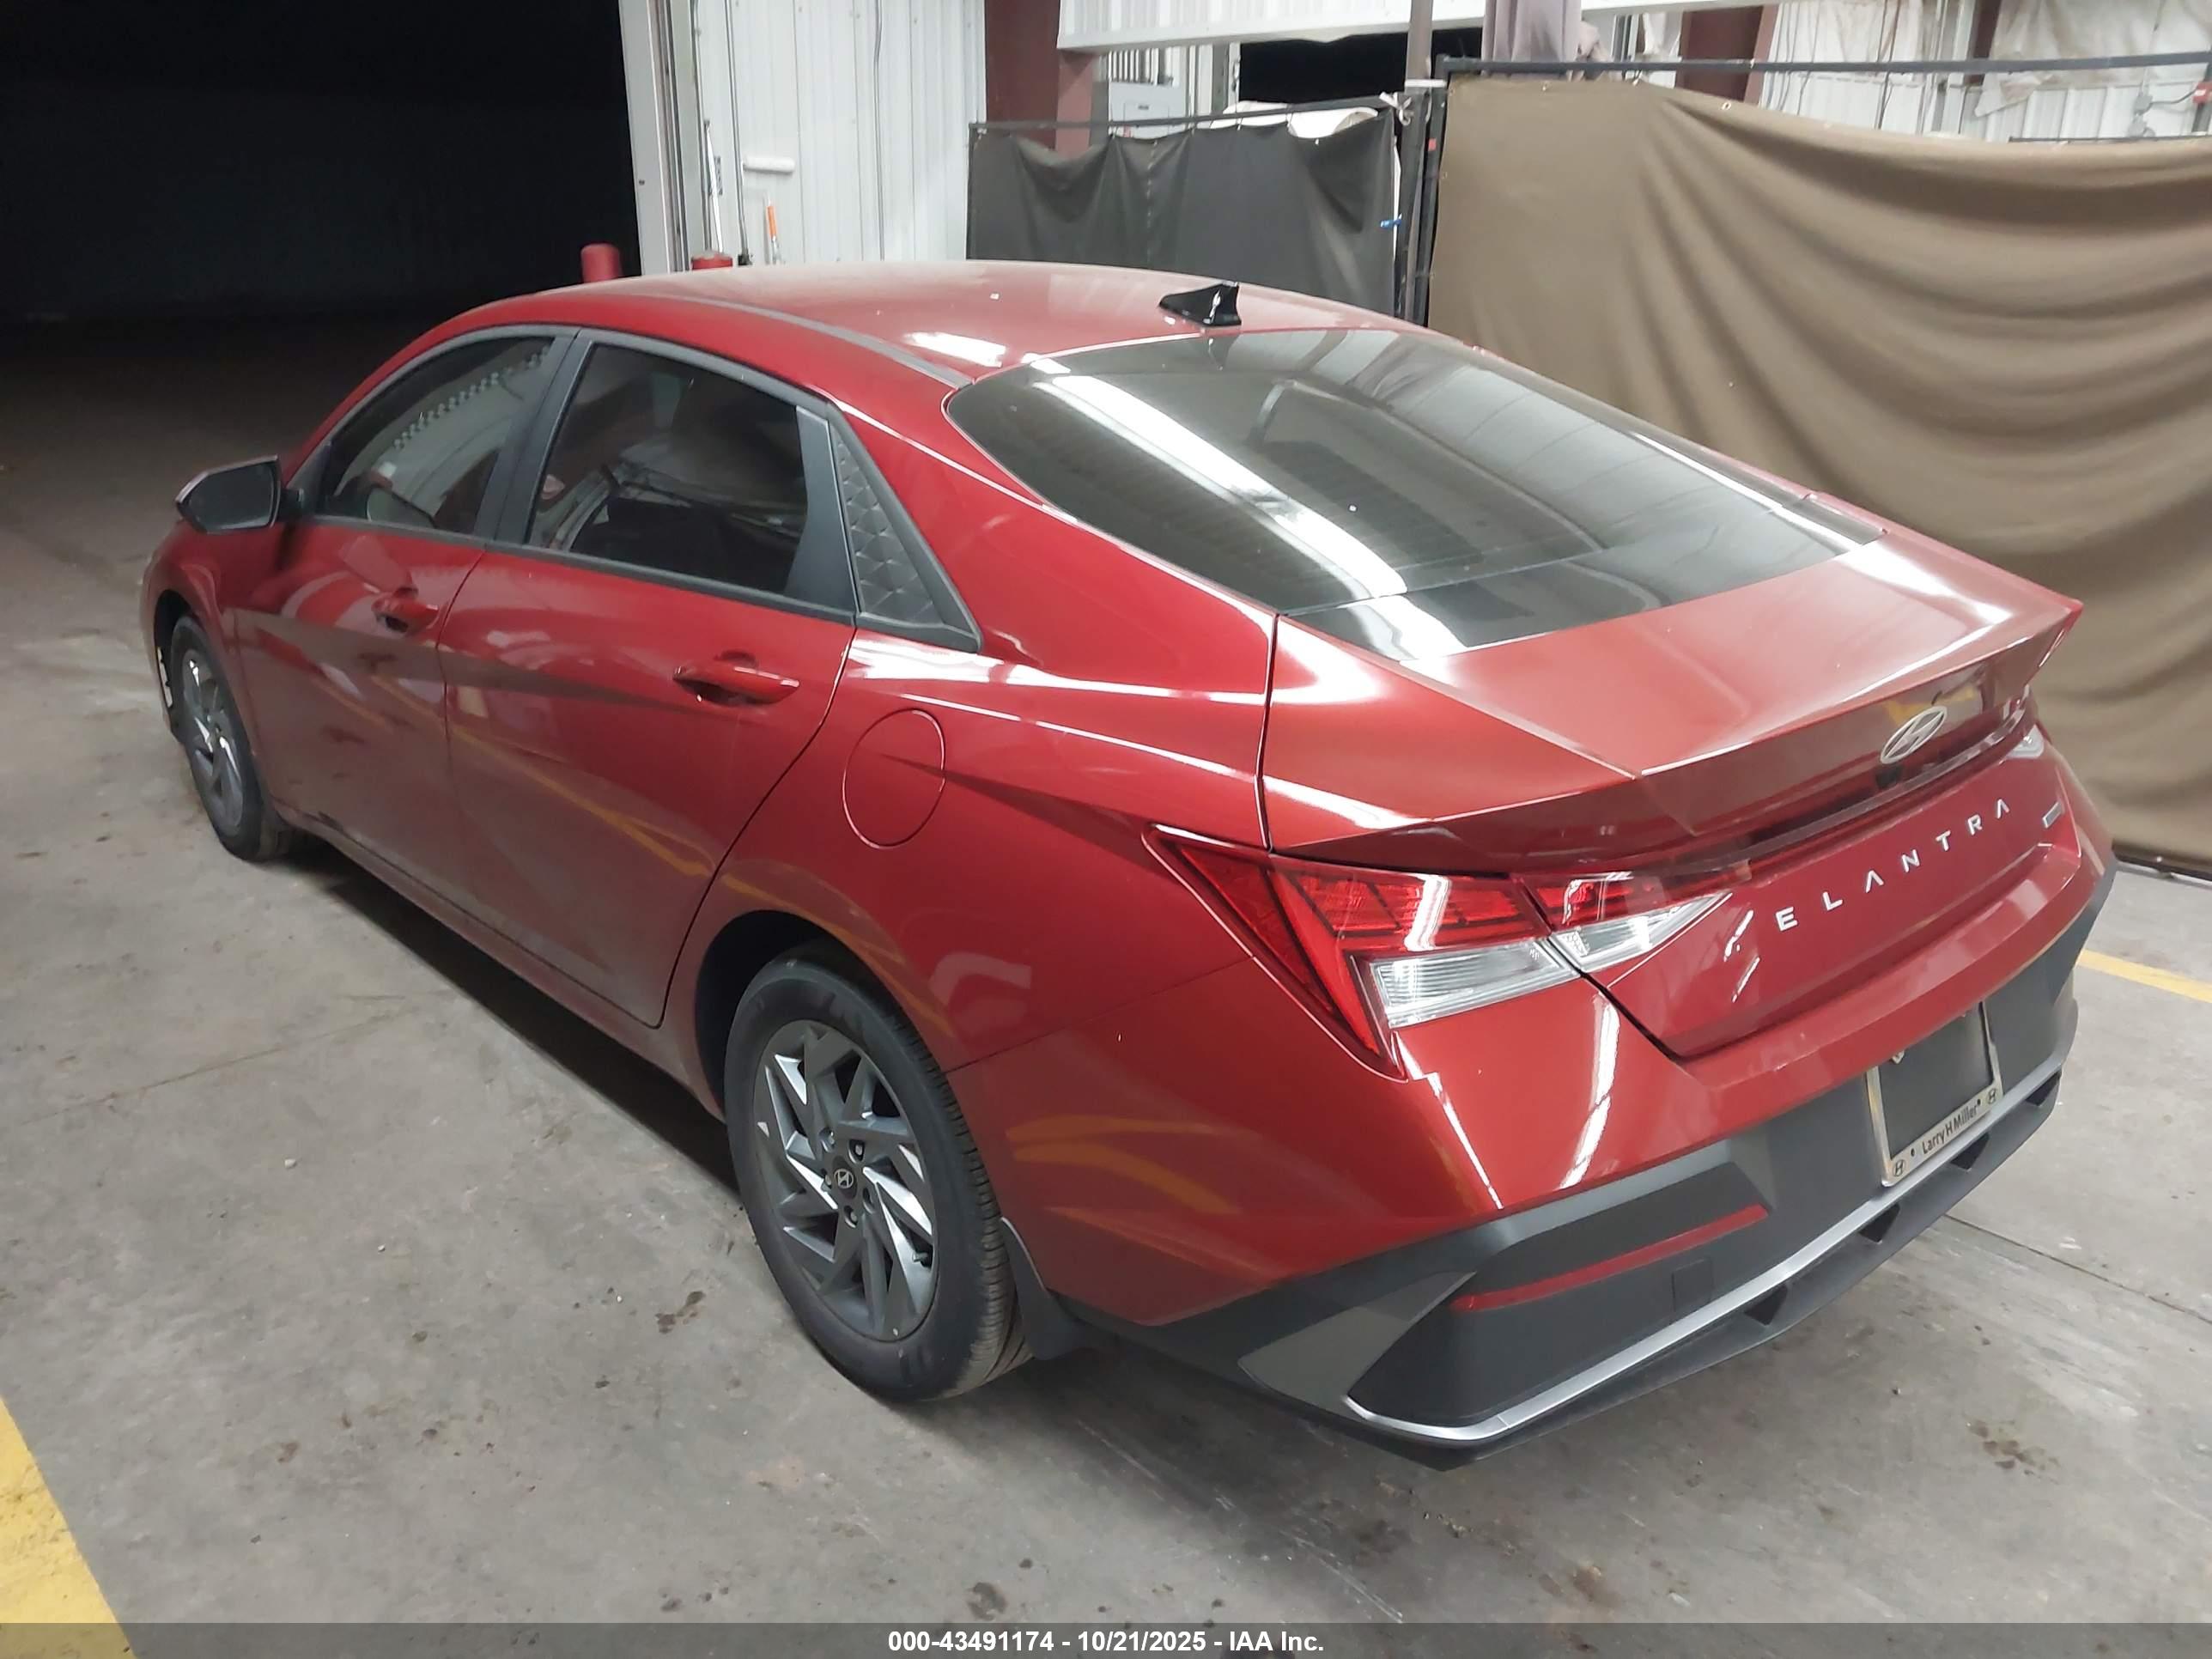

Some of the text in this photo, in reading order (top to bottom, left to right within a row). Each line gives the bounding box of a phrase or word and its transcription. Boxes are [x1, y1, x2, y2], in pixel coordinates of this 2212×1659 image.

[1775, 799, 2010, 932] ELANTRA
[1922, 1105, 1978, 1154] Larry H Miller
